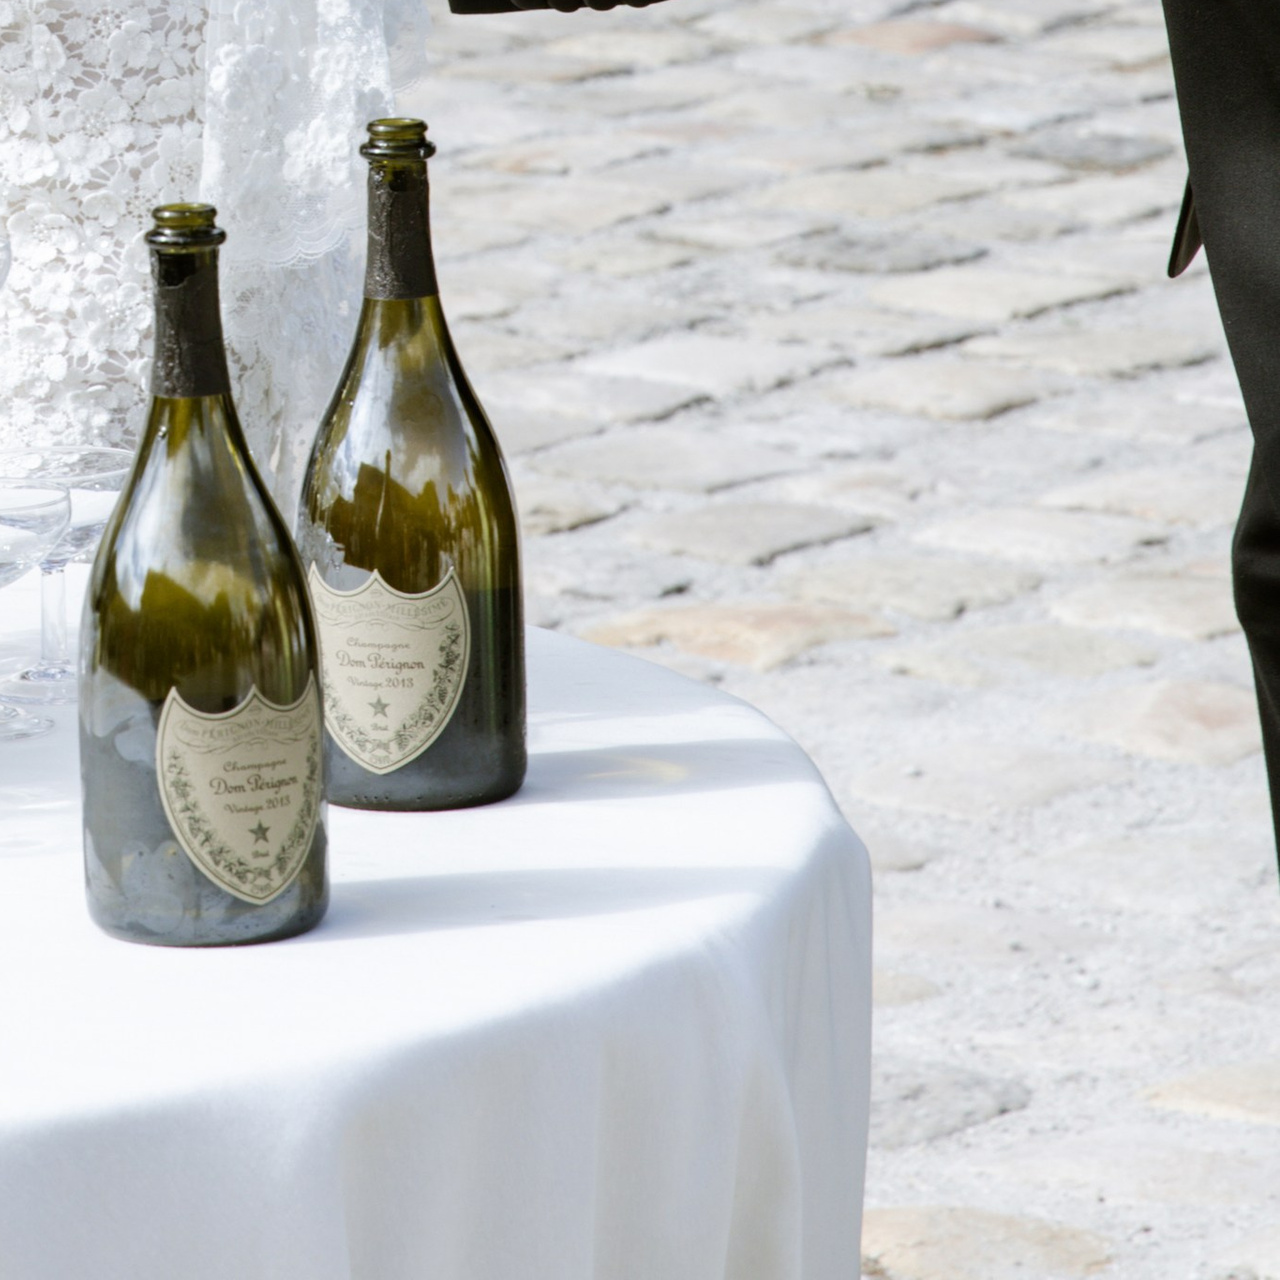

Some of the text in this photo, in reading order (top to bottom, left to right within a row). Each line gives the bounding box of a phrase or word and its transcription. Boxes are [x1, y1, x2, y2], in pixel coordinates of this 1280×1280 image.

[346, 637, 411, 651] Champagne
[336, 650, 426, 675] Dom Pérignon
[347, 676, 415, 690] Vintage 2013
[223, 758, 287, 773] Champagne
[209, 774, 299, 795] Dom Pérignon
[224, 795, 292, 815] Vintage 2013
